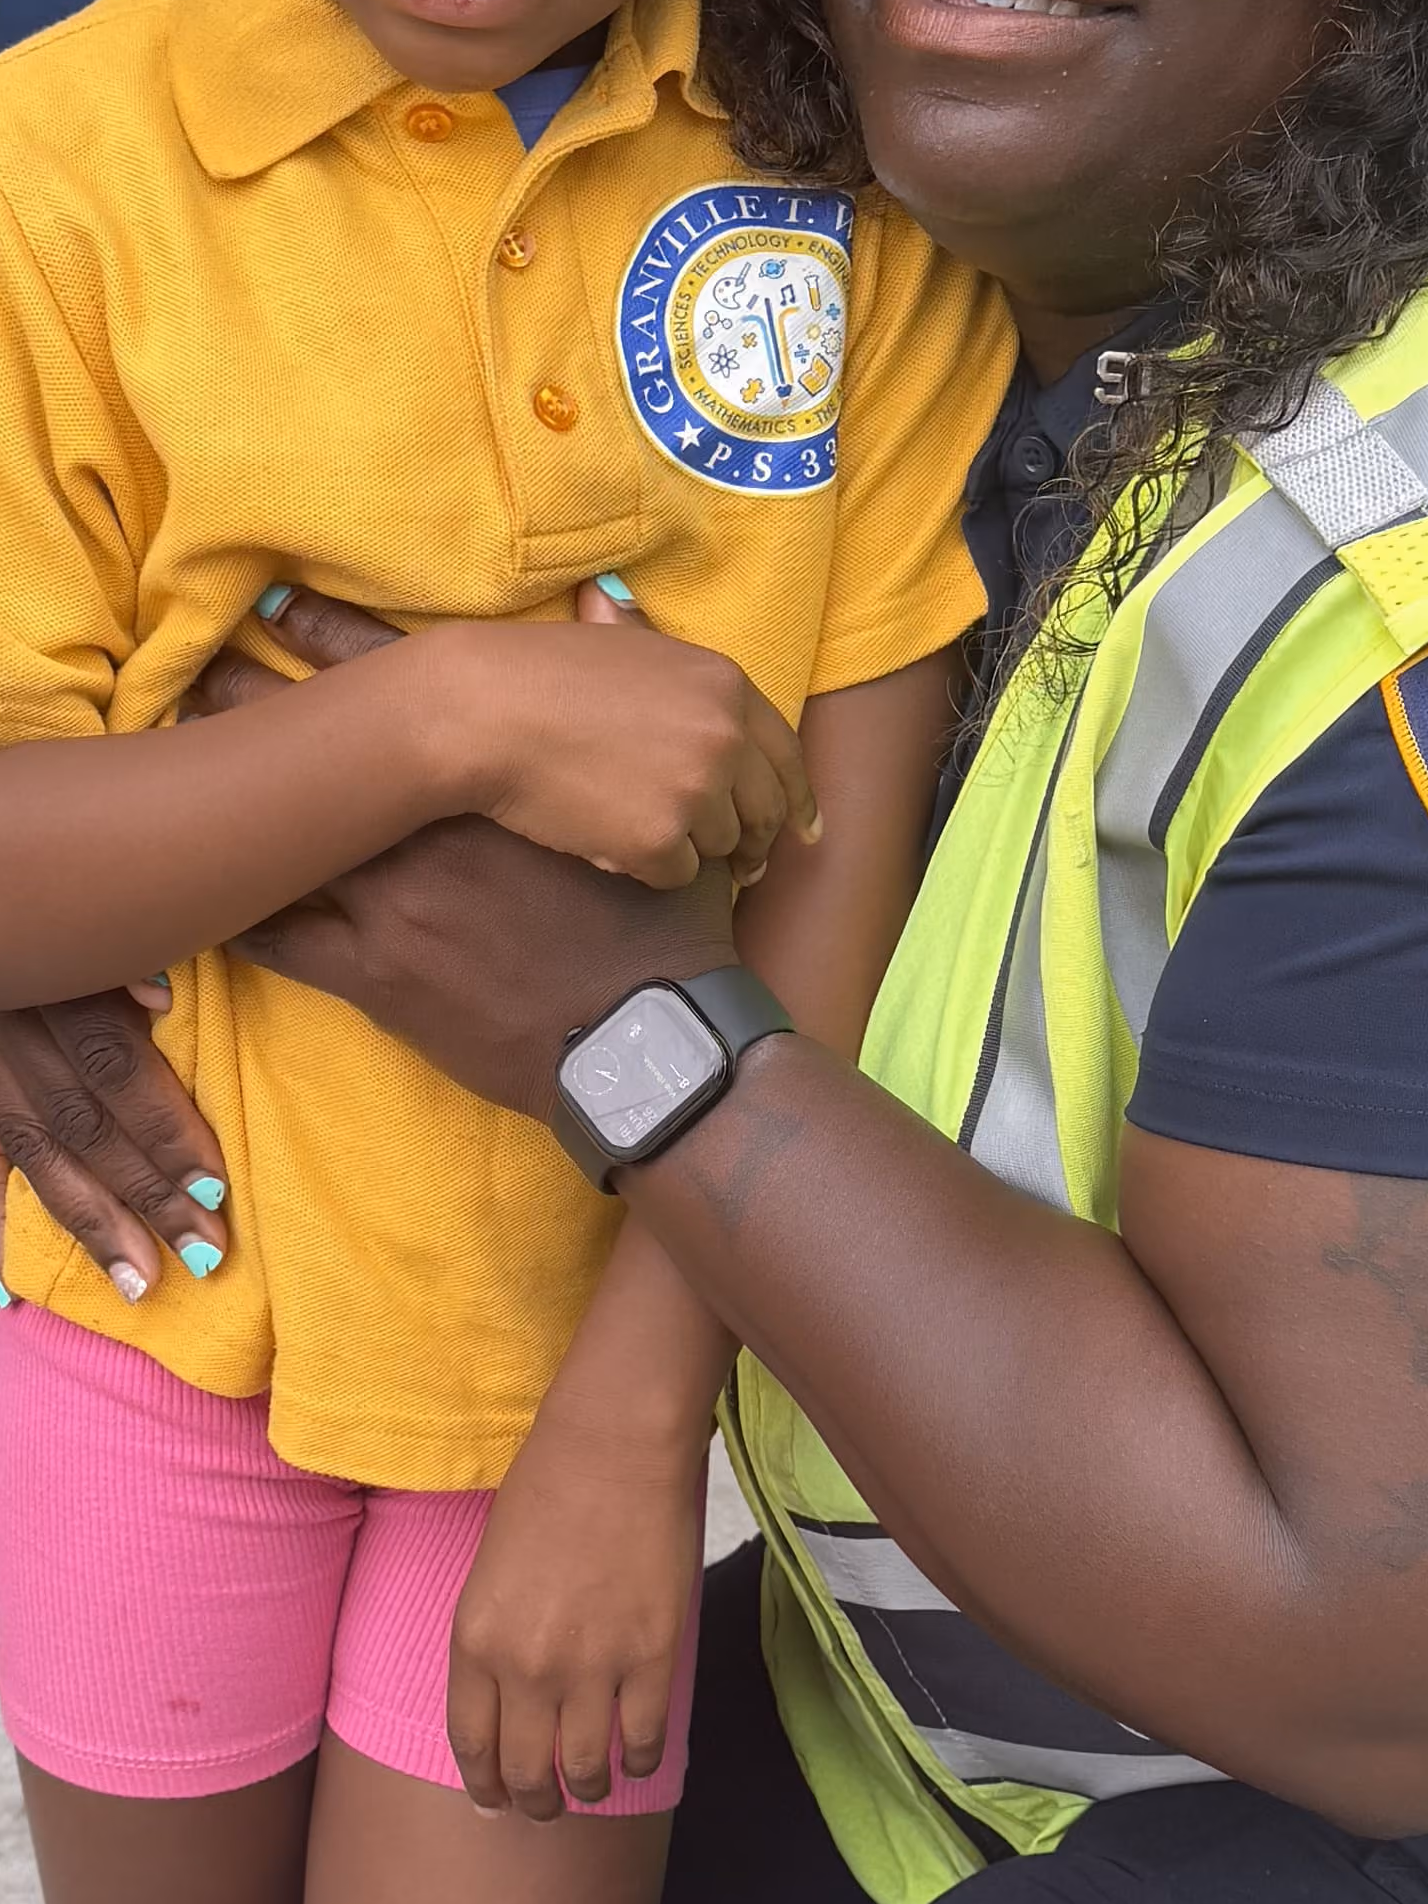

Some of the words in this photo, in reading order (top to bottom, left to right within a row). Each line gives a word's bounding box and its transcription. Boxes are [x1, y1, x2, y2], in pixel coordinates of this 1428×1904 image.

[692, 233, 793, 278] TECHNOLOGY
[631, 195, 768, 415] GRANVILLE
[777, 197, 814, 224] T.
[673, 291, 693, 370] SCIENCES
[693, 387, 796, 434] MATHEMATICS
